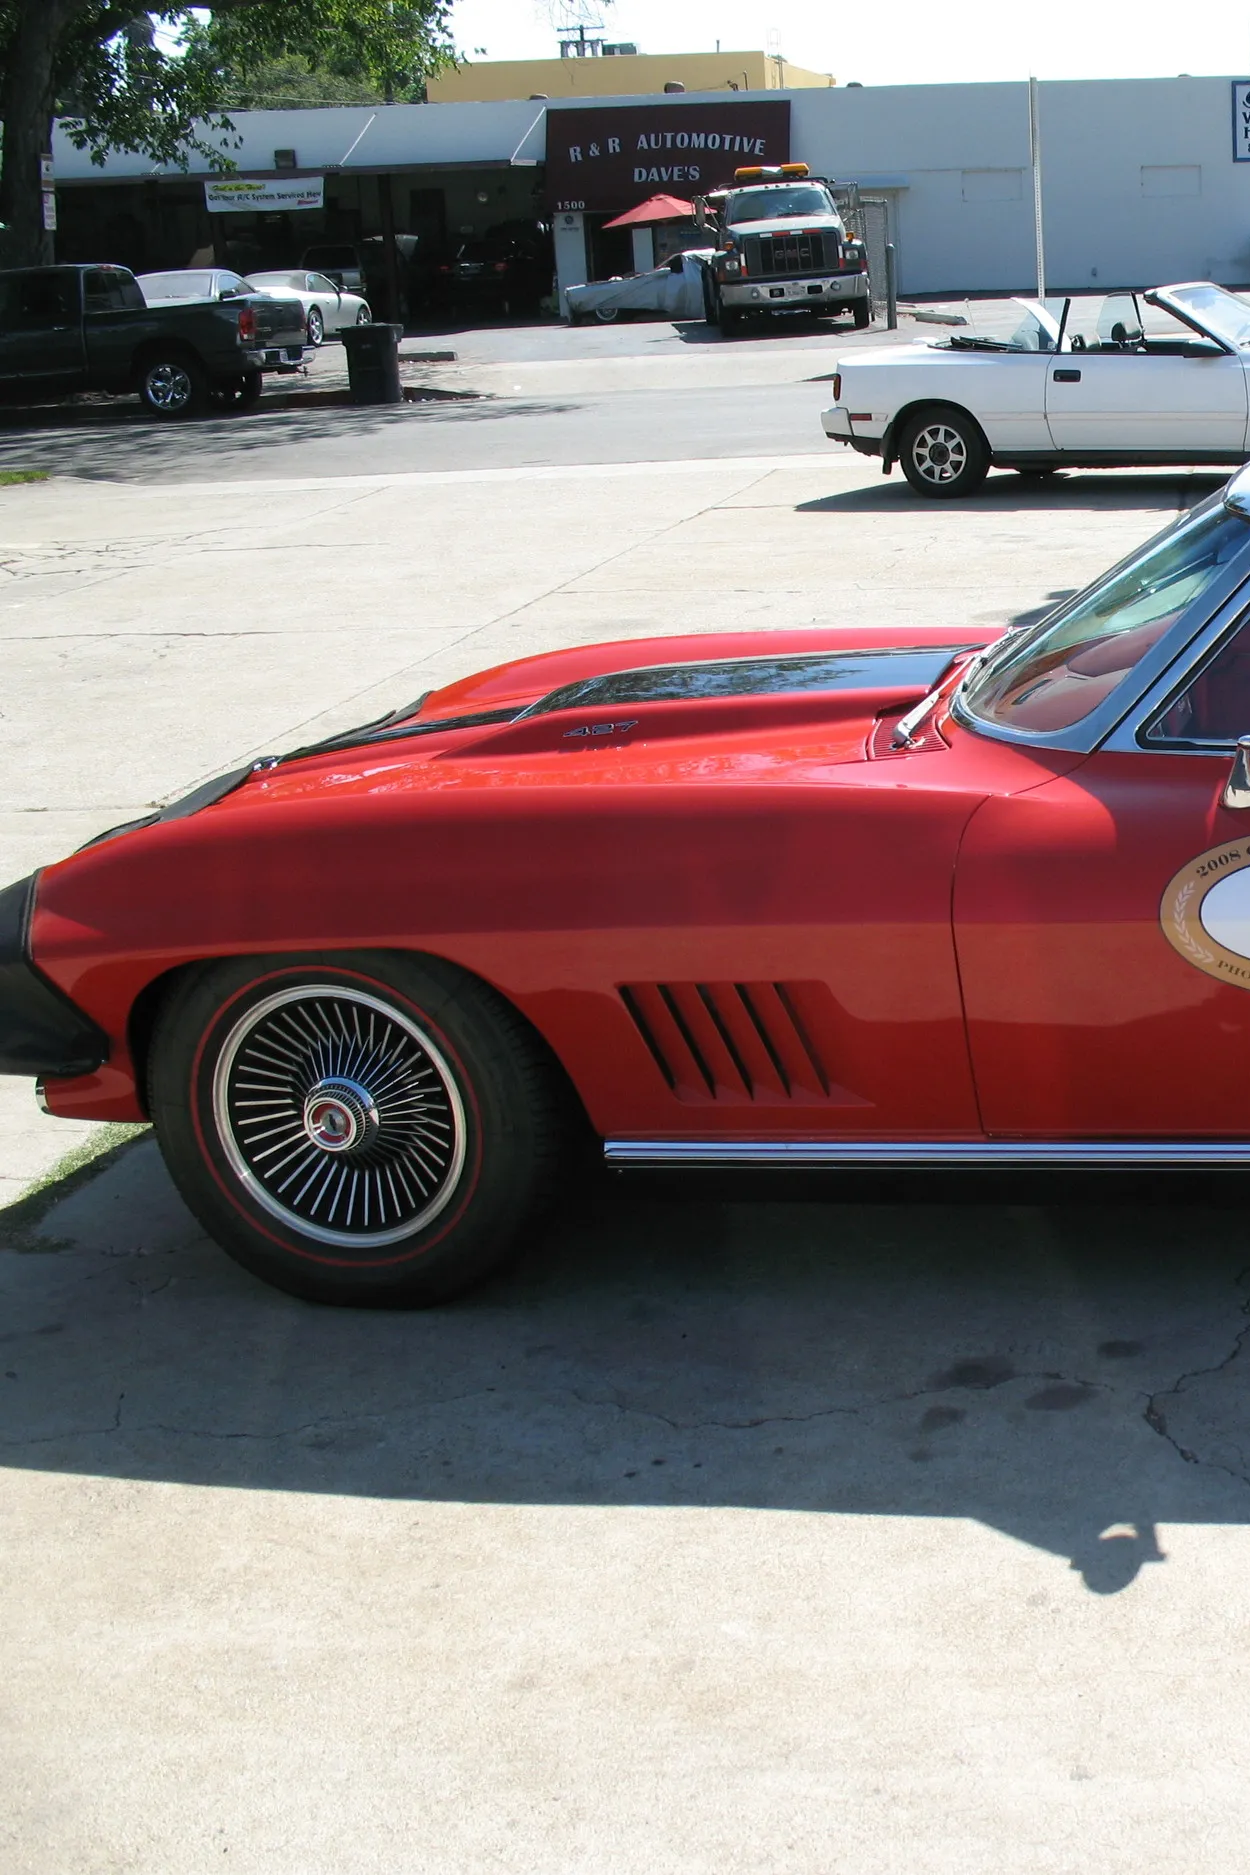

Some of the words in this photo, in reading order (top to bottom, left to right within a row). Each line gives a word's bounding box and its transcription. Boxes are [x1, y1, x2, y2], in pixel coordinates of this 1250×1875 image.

[569, 146, 583, 162] R
[589, 142, 601, 157] &
[608, 137, 621, 153] R
[637, 132, 767, 156] AUTOMOTIVE
[634, 165, 701, 183] DAVE'S
[251, 192, 276, 201] System
[277, 191, 305, 200] Serviced
[557, 201, 585, 211] 1500
[563, 720, 639, 738] 427
[1195, 849, 1243, 880] 2008
